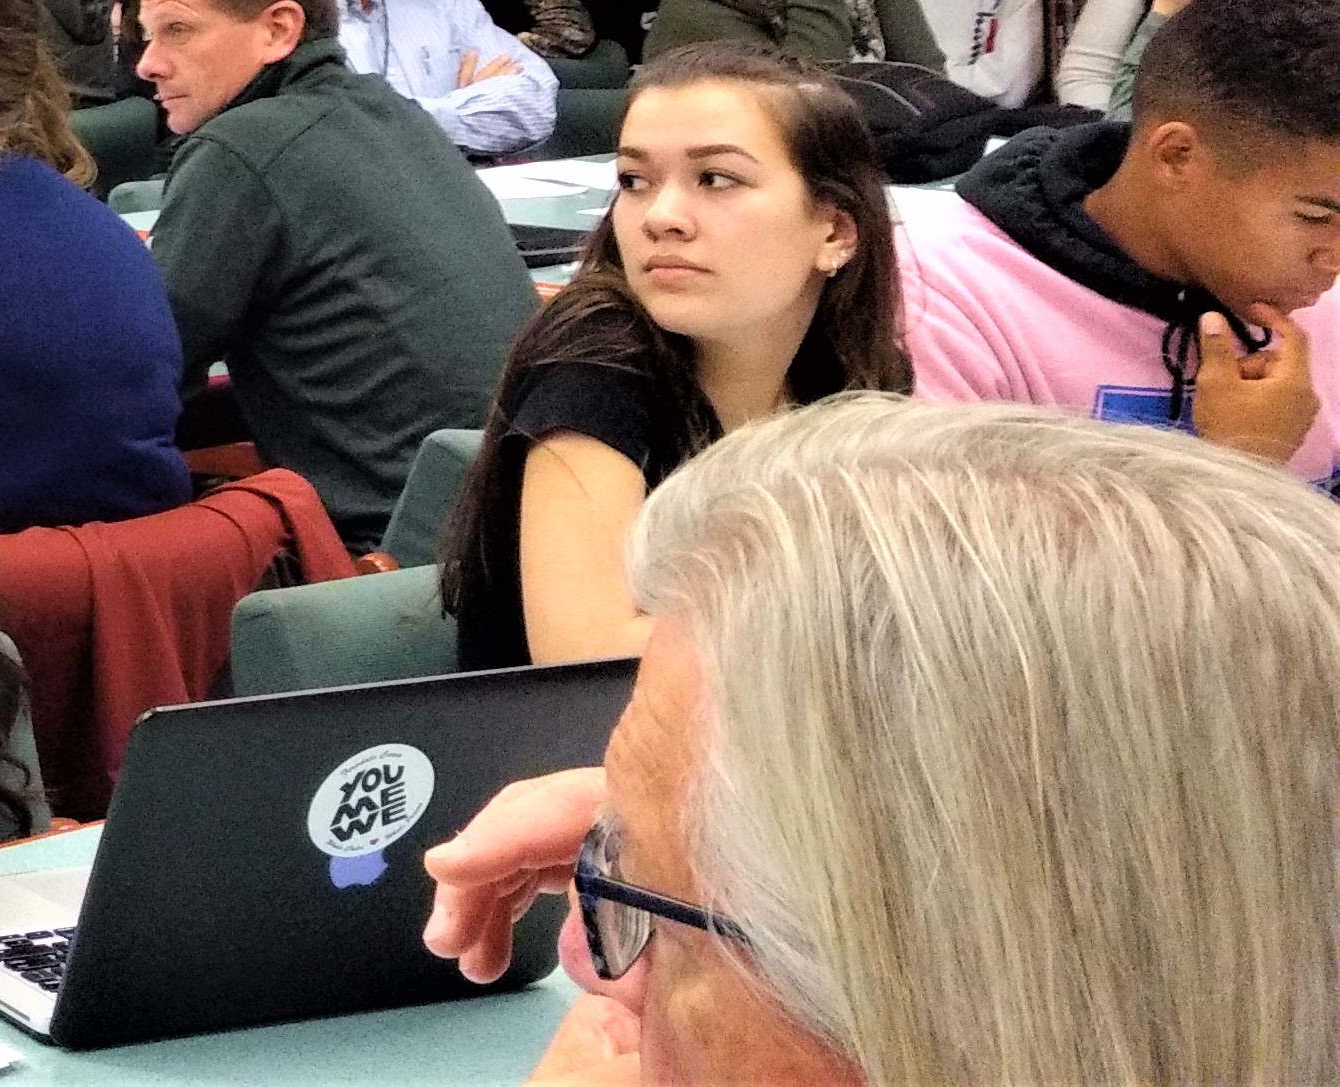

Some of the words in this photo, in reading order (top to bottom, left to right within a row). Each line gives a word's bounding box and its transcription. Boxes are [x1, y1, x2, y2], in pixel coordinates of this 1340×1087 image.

[330, 782, 407, 827] ME
[339, 764, 406, 804] YOU
[330, 800, 407, 842] WE
